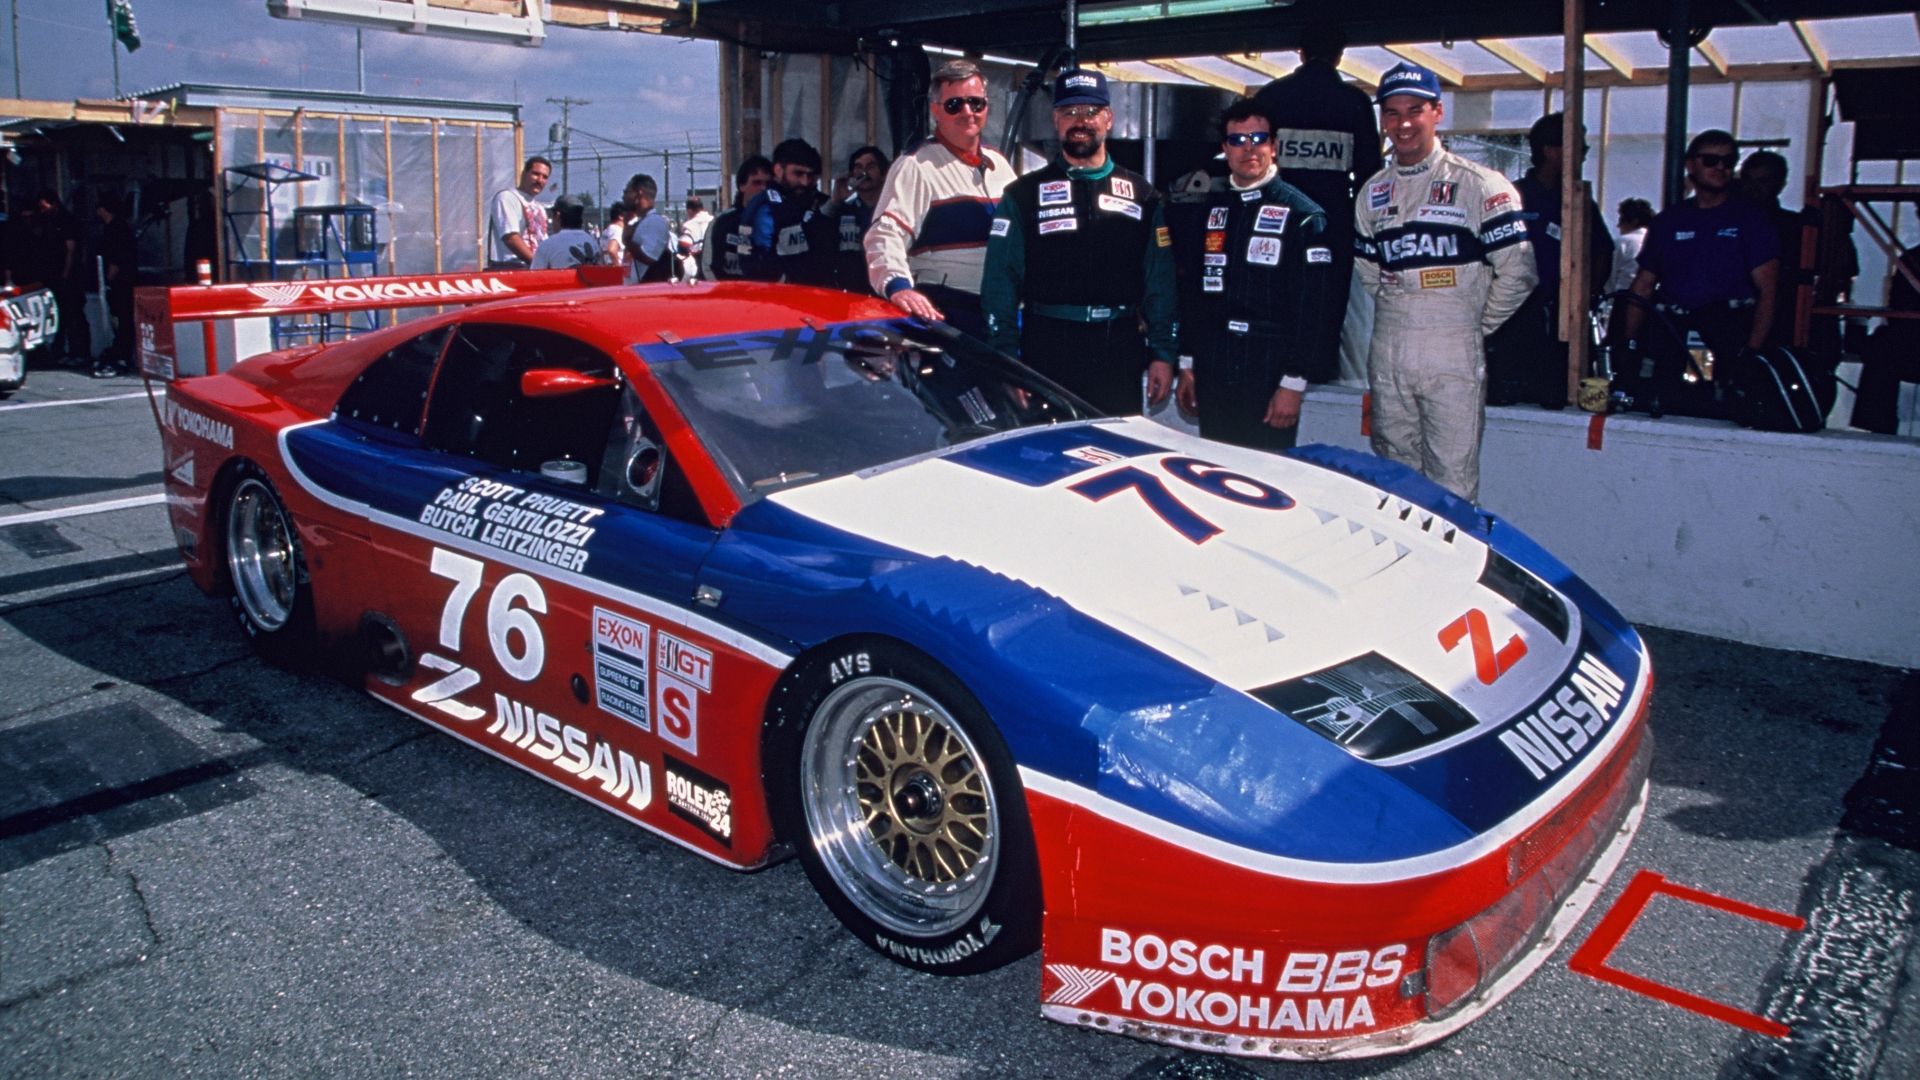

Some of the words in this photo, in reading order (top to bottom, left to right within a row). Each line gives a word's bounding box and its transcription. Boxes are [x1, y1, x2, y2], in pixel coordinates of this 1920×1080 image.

[1066, 75, 1097, 84] NISSAN
[1384, 72, 1421, 84] NISSAN
[1279, 141, 1344, 159] ISSAN
[1039, 207, 1074, 218] NISSAN
[311, 278, 515, 301] YOKOHAMA
[176, 403, 233, 451] YOKOHAMA
[434, 488, 481, 514] PAUL
[483, 502, 595, 547] GENTILOZZI
[459, 477, 525, 500] SCOTT
[519, 492, 604, 523] PRUETT
[1066, 456, 1296, 545] 76
[419, 504, 479, 538] BUTCH
[480, 522, 589, 573] LEITZINGER
[430, 547, 547, 681] 76
[598, 617, 642, 650] EXXON
[678, 649, 709, 680] GT
[830, 653, 871, 683] AVS
[1438, 608, 1528, 686] Z
[411, 653, 486, 720] Z
[600, 666, 628, 684] SUPREME
[630, 680, 639, 690] GT
[601, 691, 625, 709] RACING
[626, 703, 645, 719] FUELS
[662, 686, 691, 739] S
[1498, 652, 1626, 781] NISSAN
[486, 693, 652, 811] NISSAN
[666, 770, 714, 812] ROLEX
[709, 807, 731, 837] 24
[876, 932, 984, 965] YOKOHAMA
[1102, 928, 1264, 983] BOSCH
[1276, 944, 1407, 993] BBS
[1113, 976, 1375, 1031] YOKOHAMA
